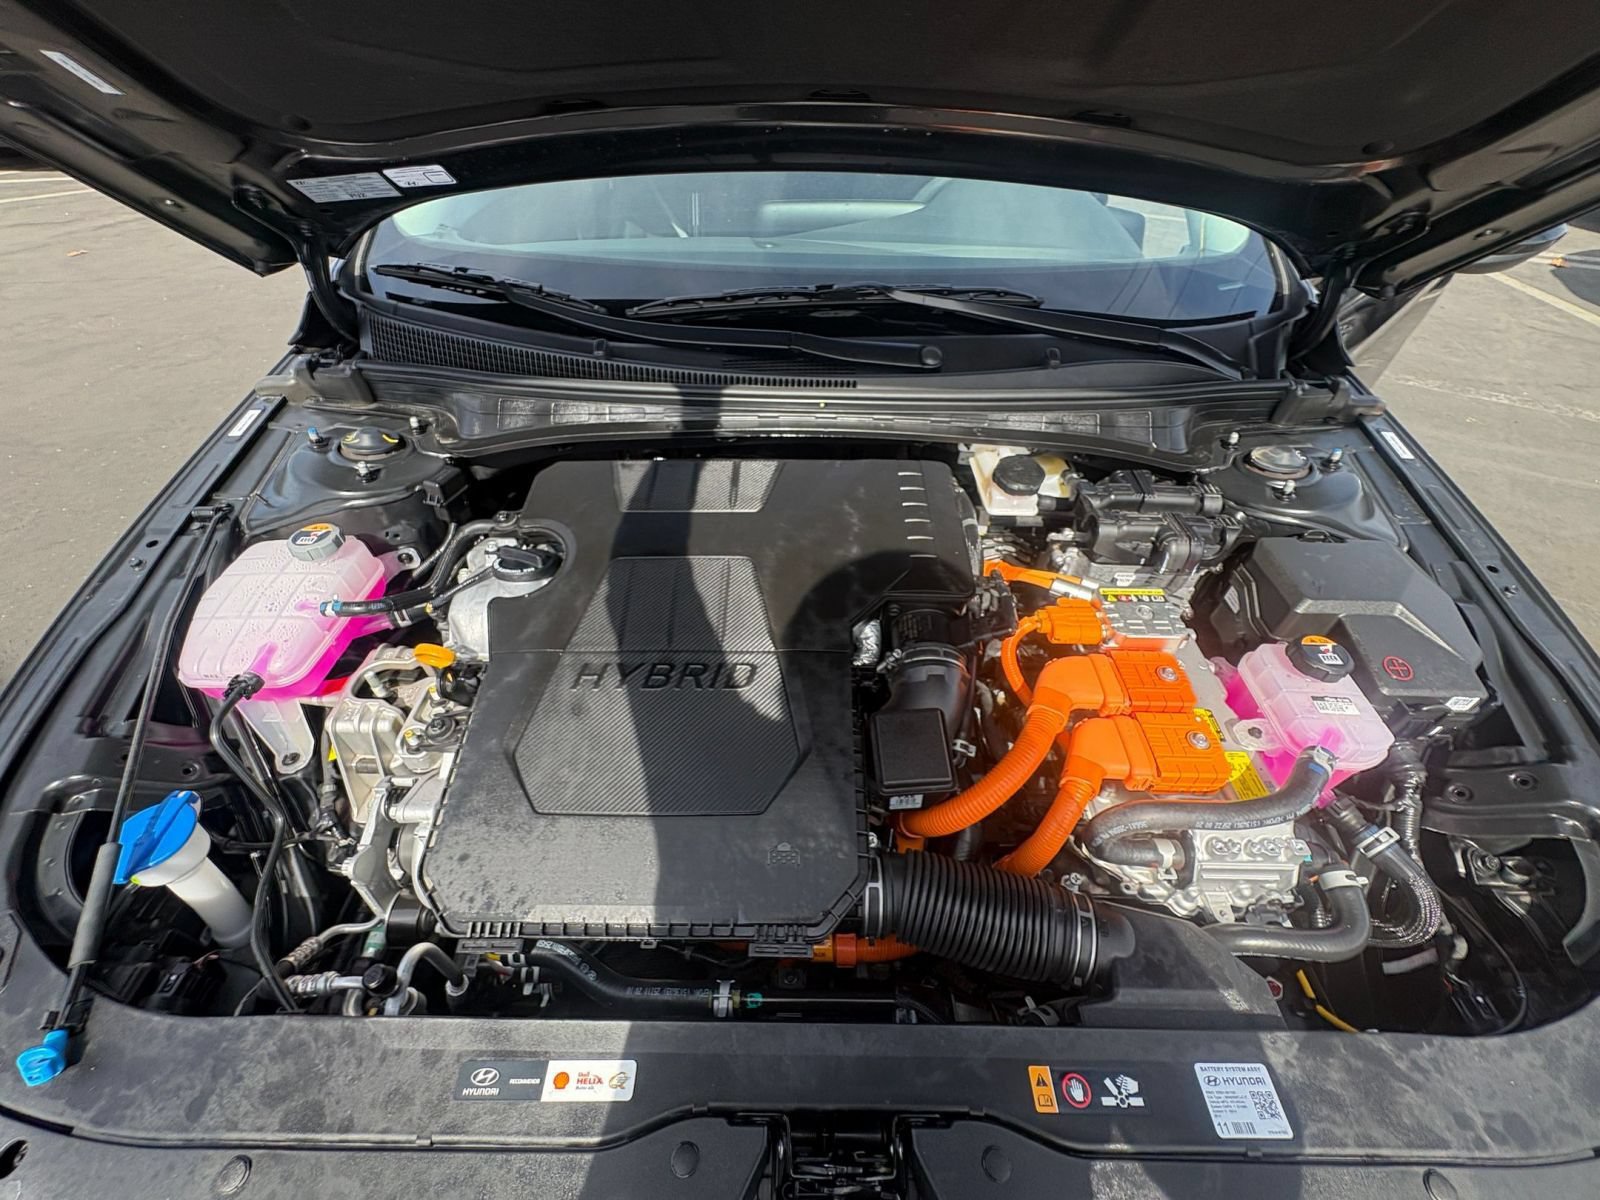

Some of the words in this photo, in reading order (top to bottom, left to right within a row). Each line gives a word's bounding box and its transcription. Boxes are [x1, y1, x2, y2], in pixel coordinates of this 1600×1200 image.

[569, 662, 758, 691] HYBRID
[576, 1076, 604, 1085] HELIX
[1221, 1076, 1267, 1086] HYUNDAI
[462, 1087, 500, 1096] HYUNDAI
